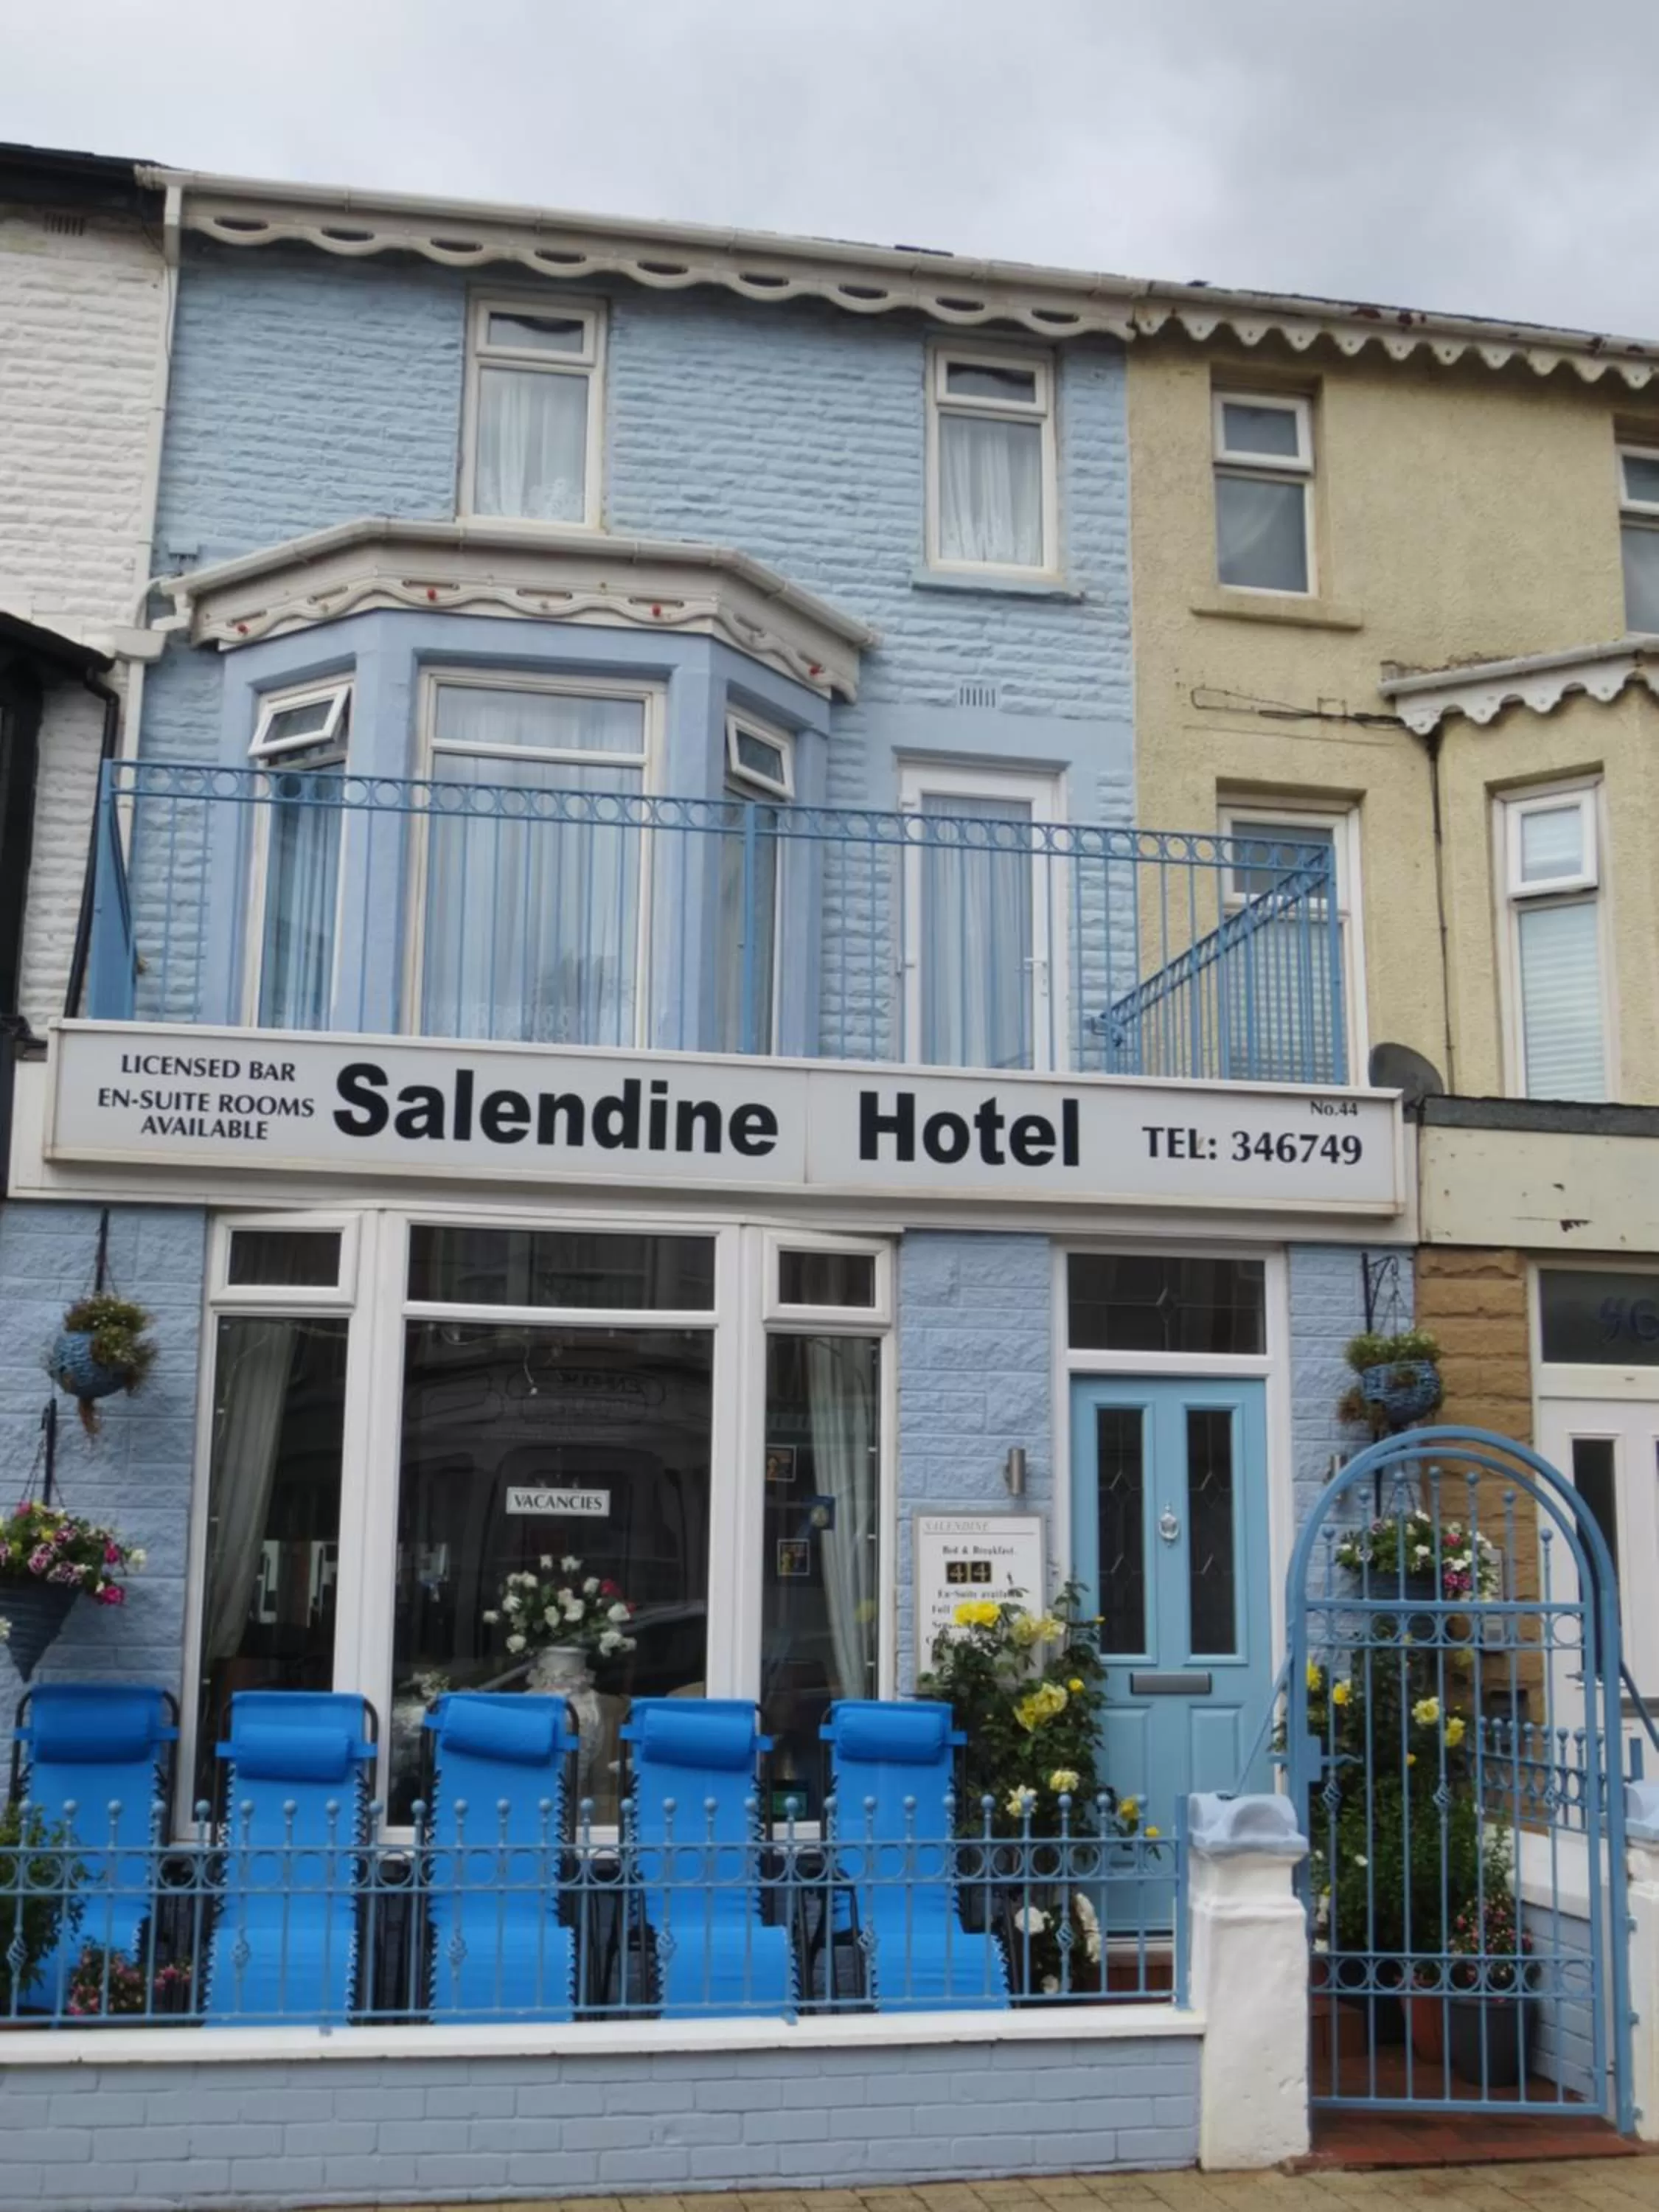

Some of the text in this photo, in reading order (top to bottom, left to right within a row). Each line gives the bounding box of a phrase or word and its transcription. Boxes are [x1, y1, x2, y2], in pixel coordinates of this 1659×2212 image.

[121, 1054, 296, 1082] LICENSED BAR
[97, 1088, 315, 1117] EN-SUITE ROOMS
[333, 1062, 1079, 1167] Salendine Hotel
[1310, 1100, 1359, 1117] No.44
[141, 1115, 268, 1140] AVAILABLE
[1141, 1126, 1363, 1165] TEL: 346749
[514, 1493, 602, 1511] VACANCIES
[948, 1562, 990, 1582] 44
